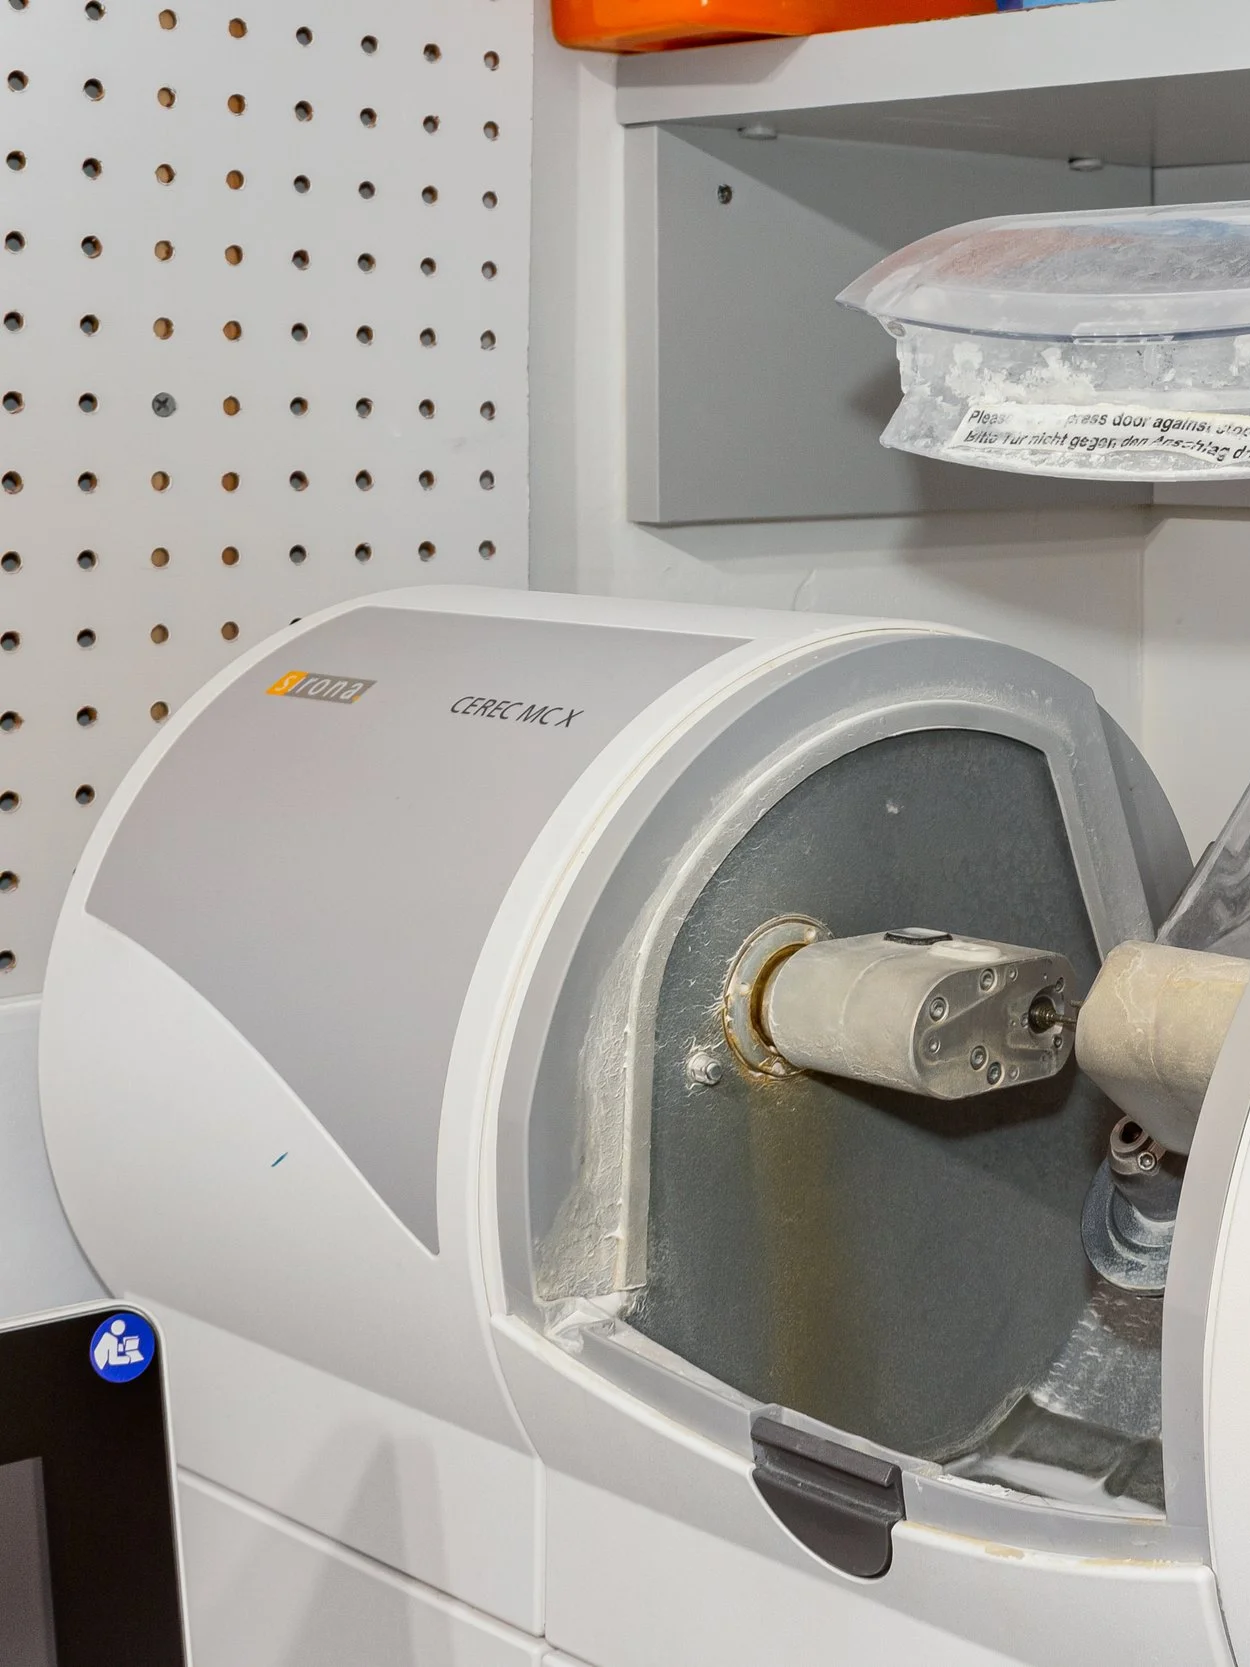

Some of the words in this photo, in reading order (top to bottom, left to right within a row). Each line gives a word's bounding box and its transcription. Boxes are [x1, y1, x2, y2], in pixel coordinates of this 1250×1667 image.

[1112, 411, 1150, 430] door
[1030, 430, 1068, 447] nicht
[450, 696, 524, 720] CEREC
[515, 704, 564, 726] MC
[554, 709, 585, 728] X
